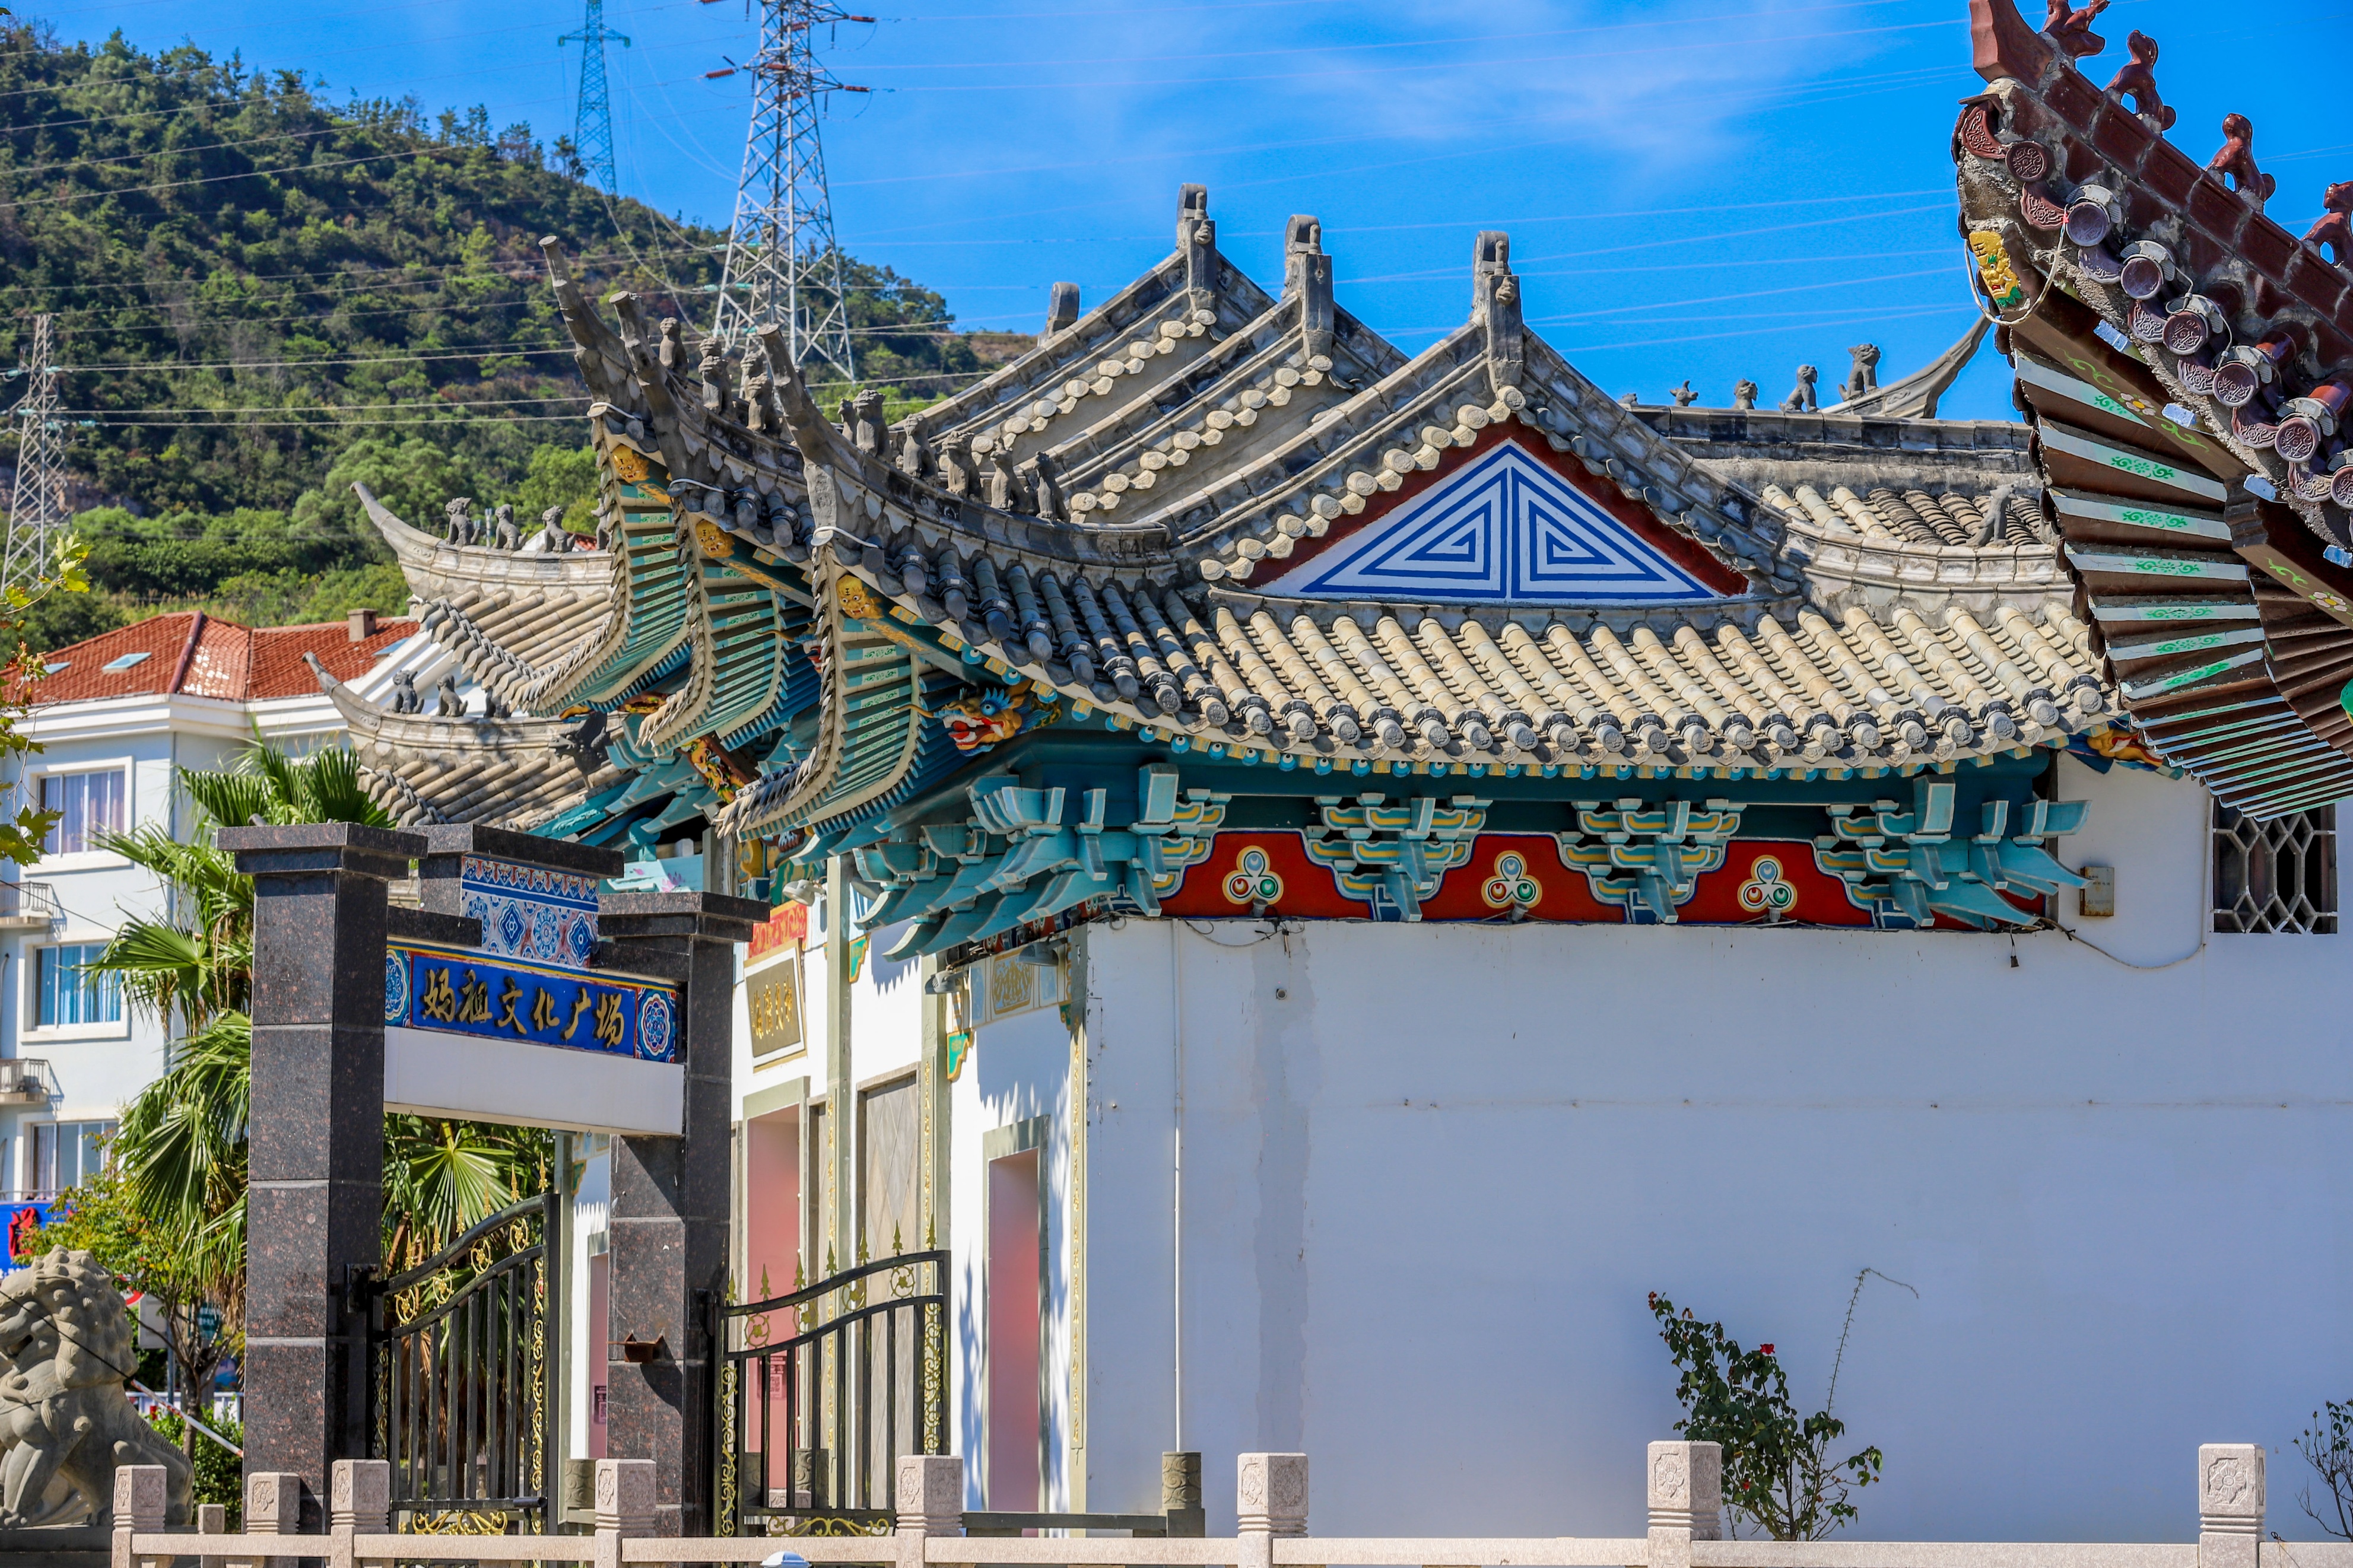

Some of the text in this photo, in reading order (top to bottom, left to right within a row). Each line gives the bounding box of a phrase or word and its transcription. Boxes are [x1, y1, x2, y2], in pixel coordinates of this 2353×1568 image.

[421, 968, 625, 1049] 妈祖文化广场
